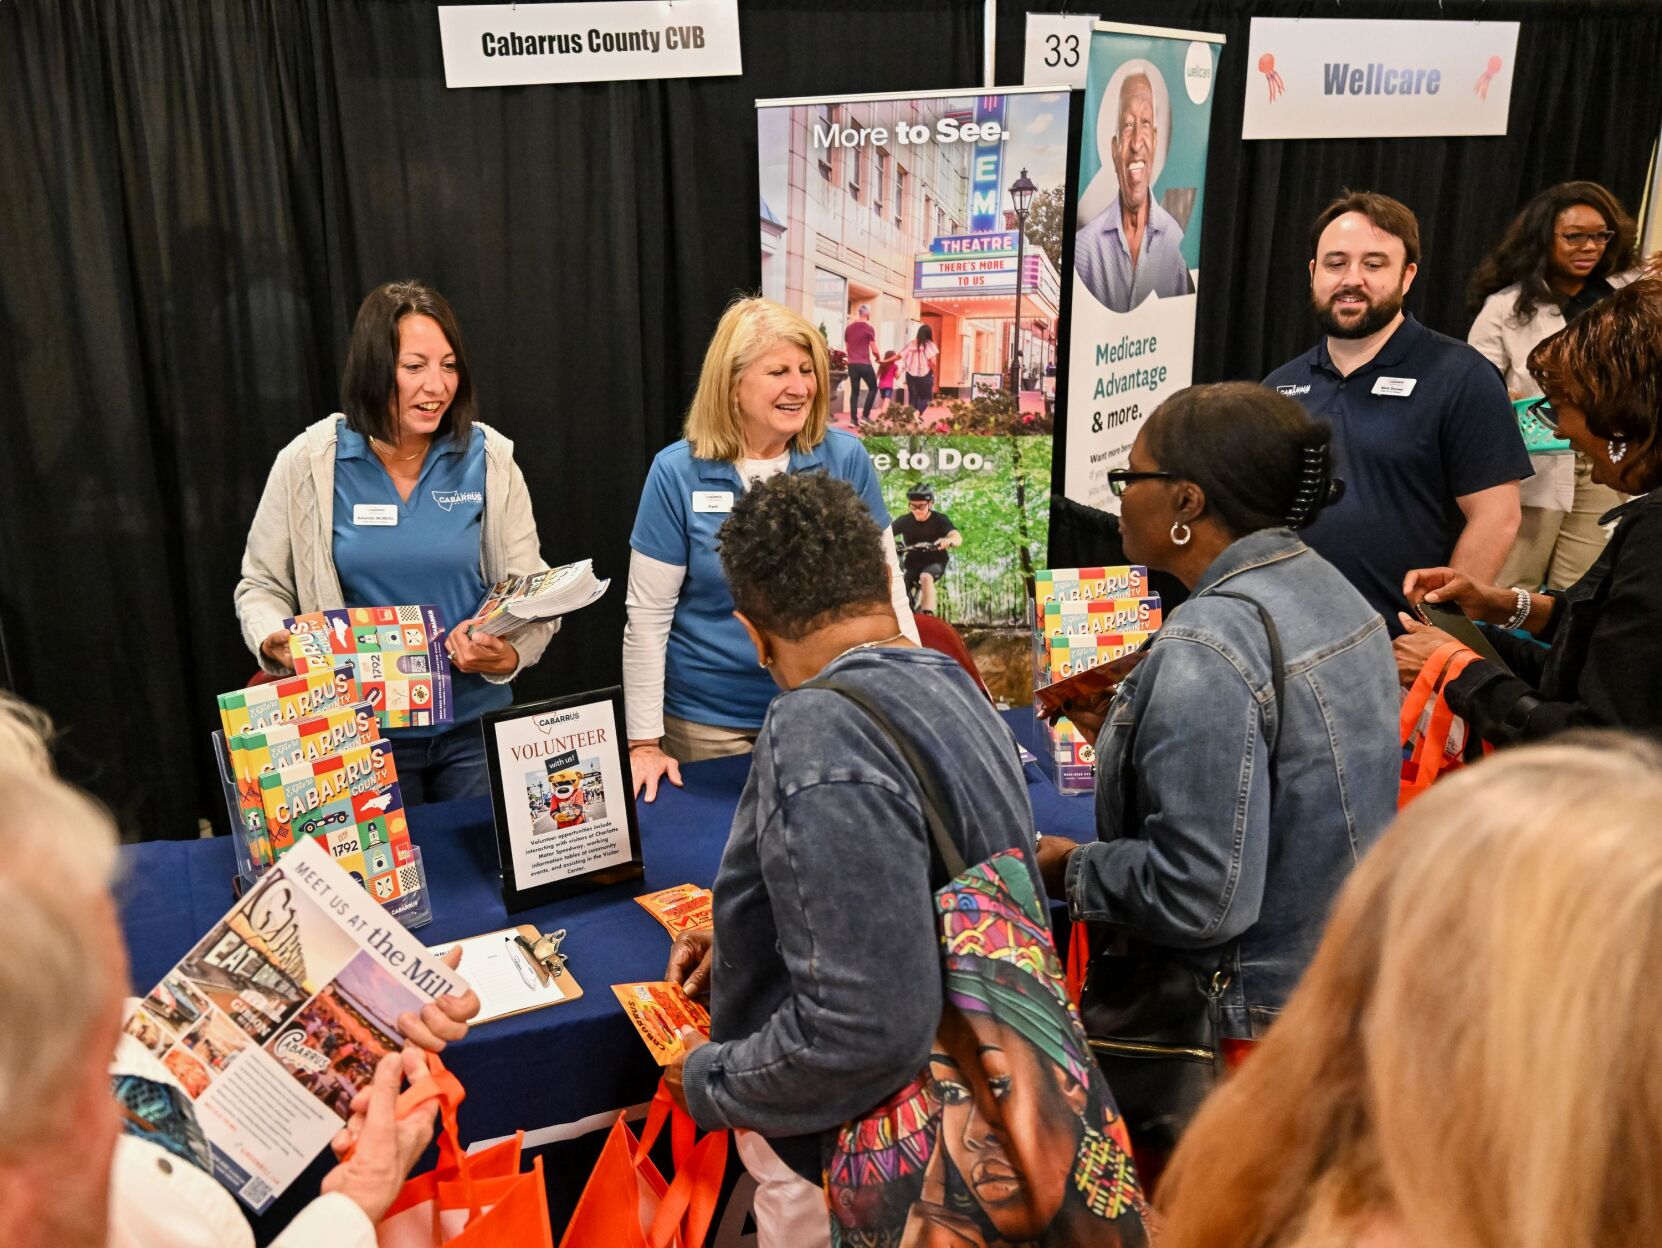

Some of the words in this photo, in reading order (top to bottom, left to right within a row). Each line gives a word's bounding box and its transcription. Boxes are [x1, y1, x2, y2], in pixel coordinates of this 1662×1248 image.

[481, 31, 583, 57] Cabarrus
[588, 28, 660, 53] County
[665, 25, 706, 50] CVB
[1043, 33, 1080, 68] 33
[1324, 62, 1441, 96] Wellcare
[812, 123, 888, 149] More
[895, 120, 930, 145] to
[935, 117, 1010, 143] See.
[941, 235, 1013, 254] THEATRE
[939, 261, 977, 273] THERE'S
[979, 259, 1005, 271] MORE
[957, 276, 970, 286] TO
[972, 275, 985, 285] US
[1096, 335, 1157, 366] Medicare
[1093, 365, 1167, 400] Advantage
[1091, 411, 1103, 433] &
[1107, 403, 1143, 429] more.
[869, 454, 891, 471] re
[897, 449, 931, 471] to
[938, 448, 992, 471] Do.
[1090, 451, 1107, 464] Want
[438, 492, 483, 504] CABARRUS
[290, 621, 330, 668] RRUS
[372, 654, 382, 679] 1792
[539, 712, 580, 727] CABARRUS
[510, 728, 608, 762] VOLUNTEER
[549, 758, 564, 771] with
[564, 754, 576, 765] us!
[275, 748, 386, 824] CABARRUS
[352, 768, 388, 796] COUNTY
[525, 843, 555, 855] interacting
[568, 835, 588, 844] visitors
[595, 827, 619, 837] Charlotte
[530, 835, 557, 846] Volunteer
[557, 826, 593, 839] opportunities
[593, 821, 612, 830] include
[332, 840, 359, 858] 1792
[531, 856, 563, 869] information
[564, 852, 580, 860] tables
[588, 842, 617, 854] community
[538, 851, 555, 859] Motor
[586, 837, 609, 847] working
[530, 869, 550, 877] events,
[551, 863, 562, 871] and
[563, 857, 586, 868] assisting
[602, 849, 620, 857] Visitor
[567, 866, 586, 874] Center.
[294, 860, 330, 896] MEET
[329, 893, 349, 917] US
[346, 912, 368, 933] AT
[363, 925, 406, 968] the
[401, 956, 453, 999] Mill
